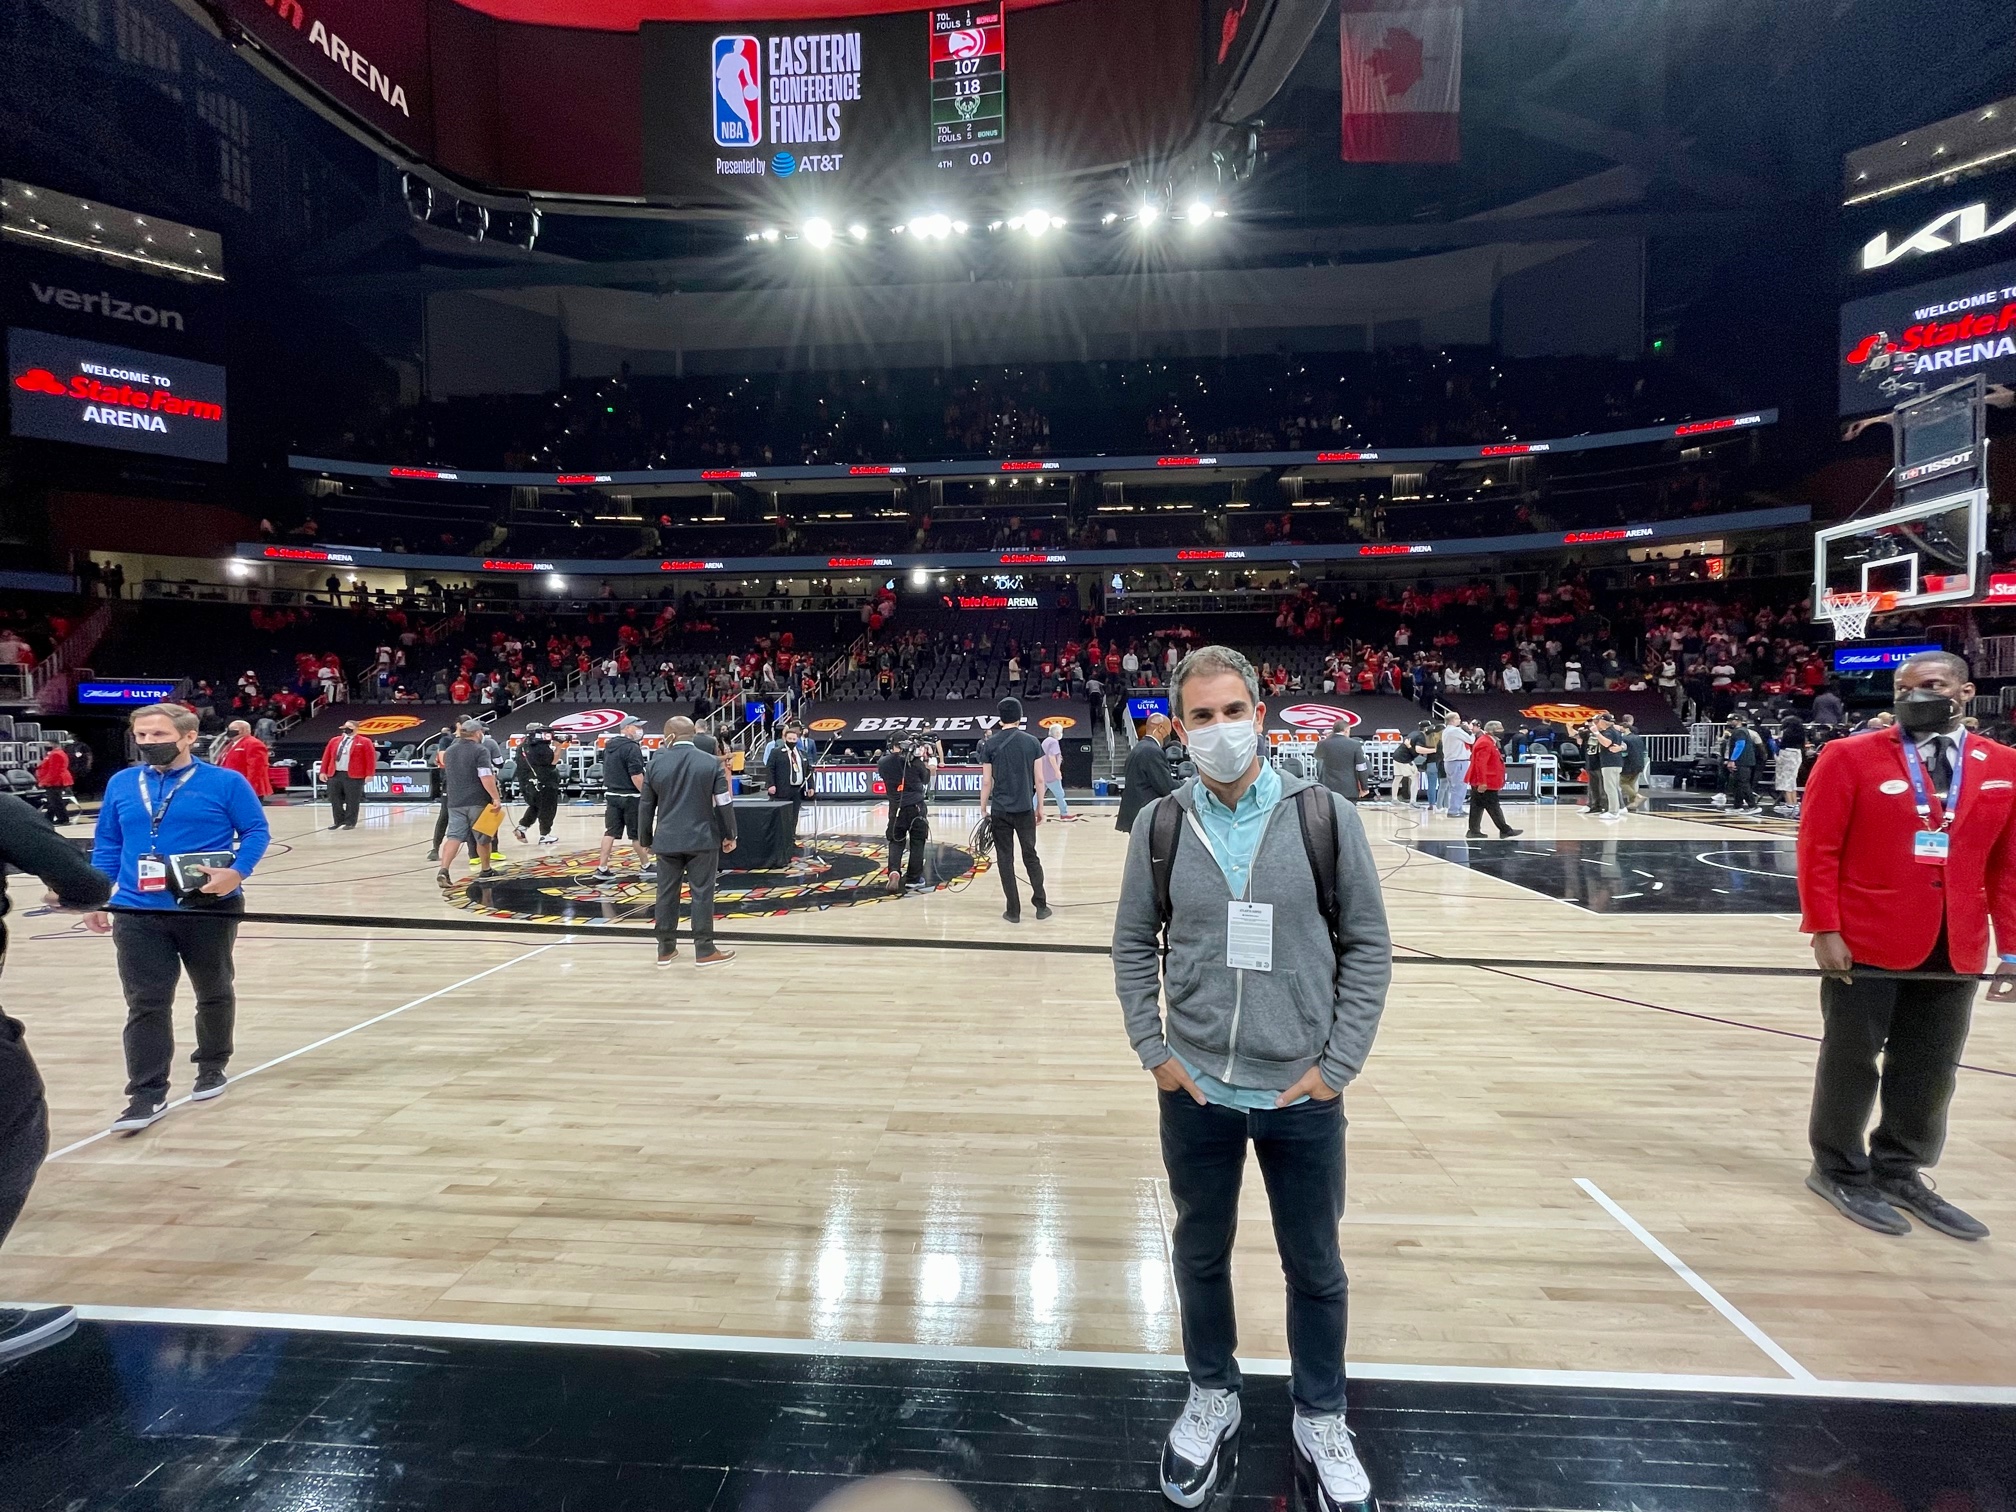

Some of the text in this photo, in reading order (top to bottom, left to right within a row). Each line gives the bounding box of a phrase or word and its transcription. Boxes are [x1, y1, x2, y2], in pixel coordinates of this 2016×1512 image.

[936, 19, 971, 30] FOULS 5
[937, 13, 950, 21] TOL
[768, 32, 861, 76] EASTERN
[308, 19, 410, 118] ARENA
[954, 59, 981, 75] 107
[769, 72, 861, 104] CONFERENCE
[954, 79, 981, 96] 118
[721, 121, 743, 139] NBA
[770, 103, 841, 144] FINALS
[938, 126, 951, 135] TOL
[937, 132, 972, 143] FOULS 5
[977, 130, 998, 138] BONUS
[716, 157, 766, 176] Presented by
[798, 154, 844, 173] AT&T
[937, 161, 953, 169] 4TH
[970, 152, 992, 165] 0.0
[30, 281, 184, 332] verizon
[1914, 291, 1998, 319] WELCOME
[1913, 336, 2016, 375] ARENA
[81, 362, 171, 388] WELCOME TO
[83, 406, 168, 434] ARENA
[1734, 415, 1760, 426] ARENA
[1528, 444, 1549, 452] ARENA
[1918, 450, 1974, 475] TISSOT
[437, 472, 457, 480] ARENA
[1626, 528, 1653, 537] ARENA
[327, 554, 353, 562] ARENA
[1007, 597, 1038, 607] ARENA
[825, 771, 867, 793] FINALS
[937, 774, 963, 791] NEXT
